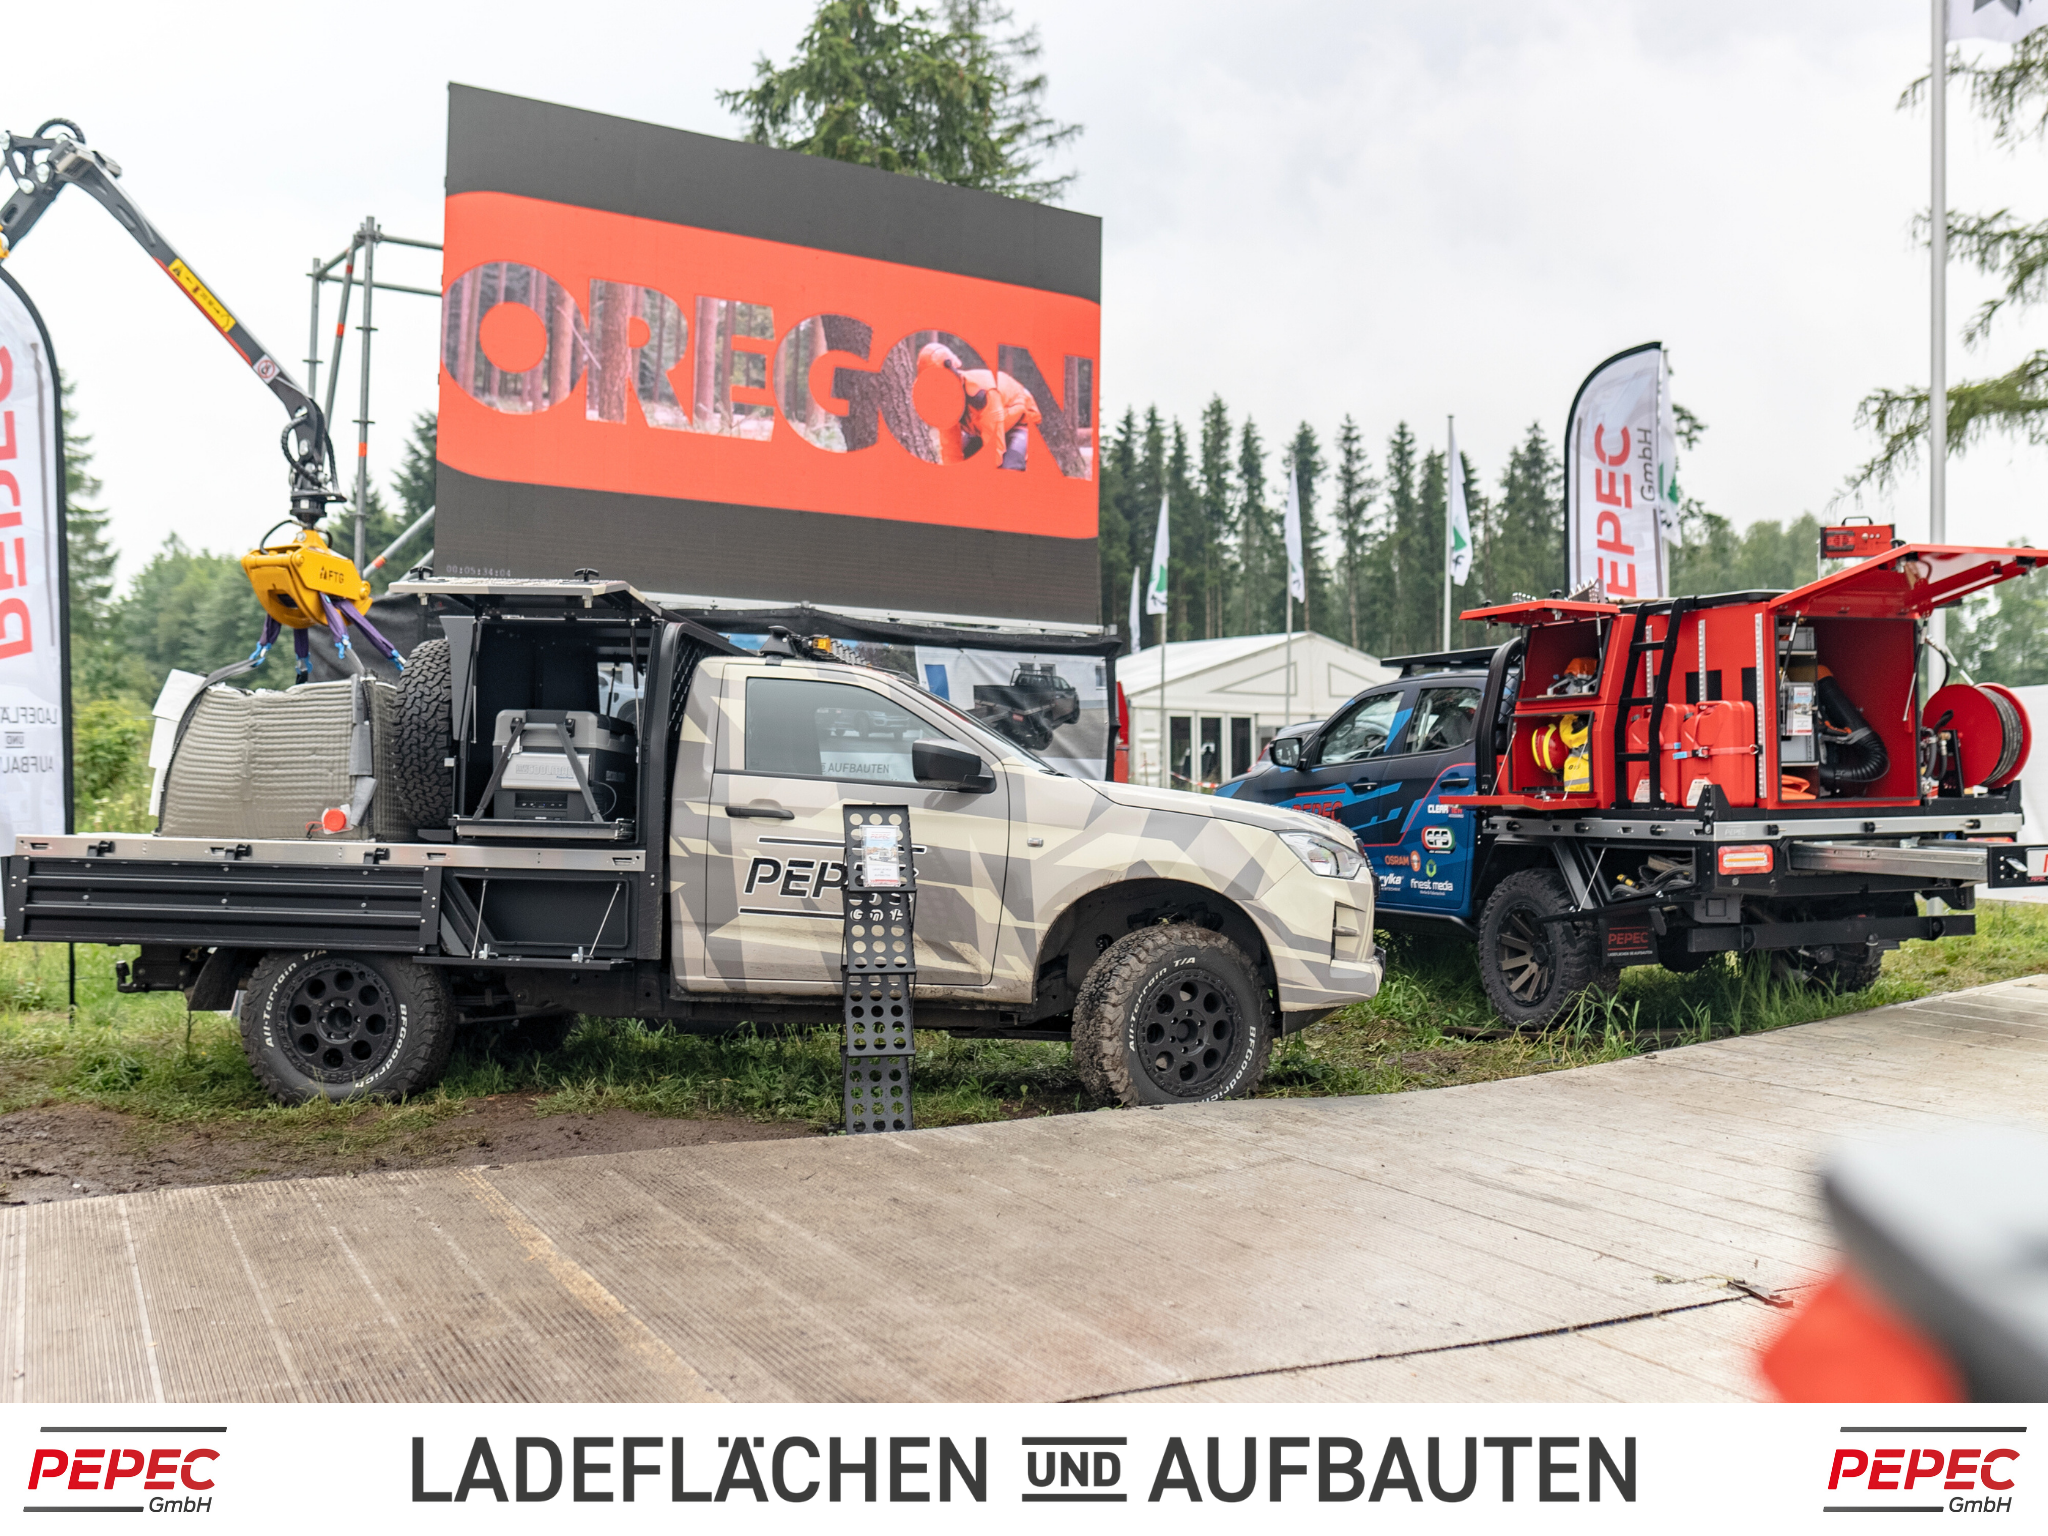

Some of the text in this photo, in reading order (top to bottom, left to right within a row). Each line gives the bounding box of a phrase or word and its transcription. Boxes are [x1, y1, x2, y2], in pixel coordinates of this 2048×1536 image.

[440, 261, 1093, 481] OREGON
[1637, 428, 1656, 502] GmbH
[1594, 422, 1637, 598] EPEC
[827, 763, 889, 774] AUFBAUTEN
[1385, 855, 1409, 866] OSRAM
[1410, 878, 1454, 891] finest media
[1608, 932, 1648, 945] PEPEC
[263, 962, 297, 1048] All-Terrain
[1129, 956, 1196, 1052] All-Terrain T/A
[354, 1003, 408, 1089] BFGoodrich
